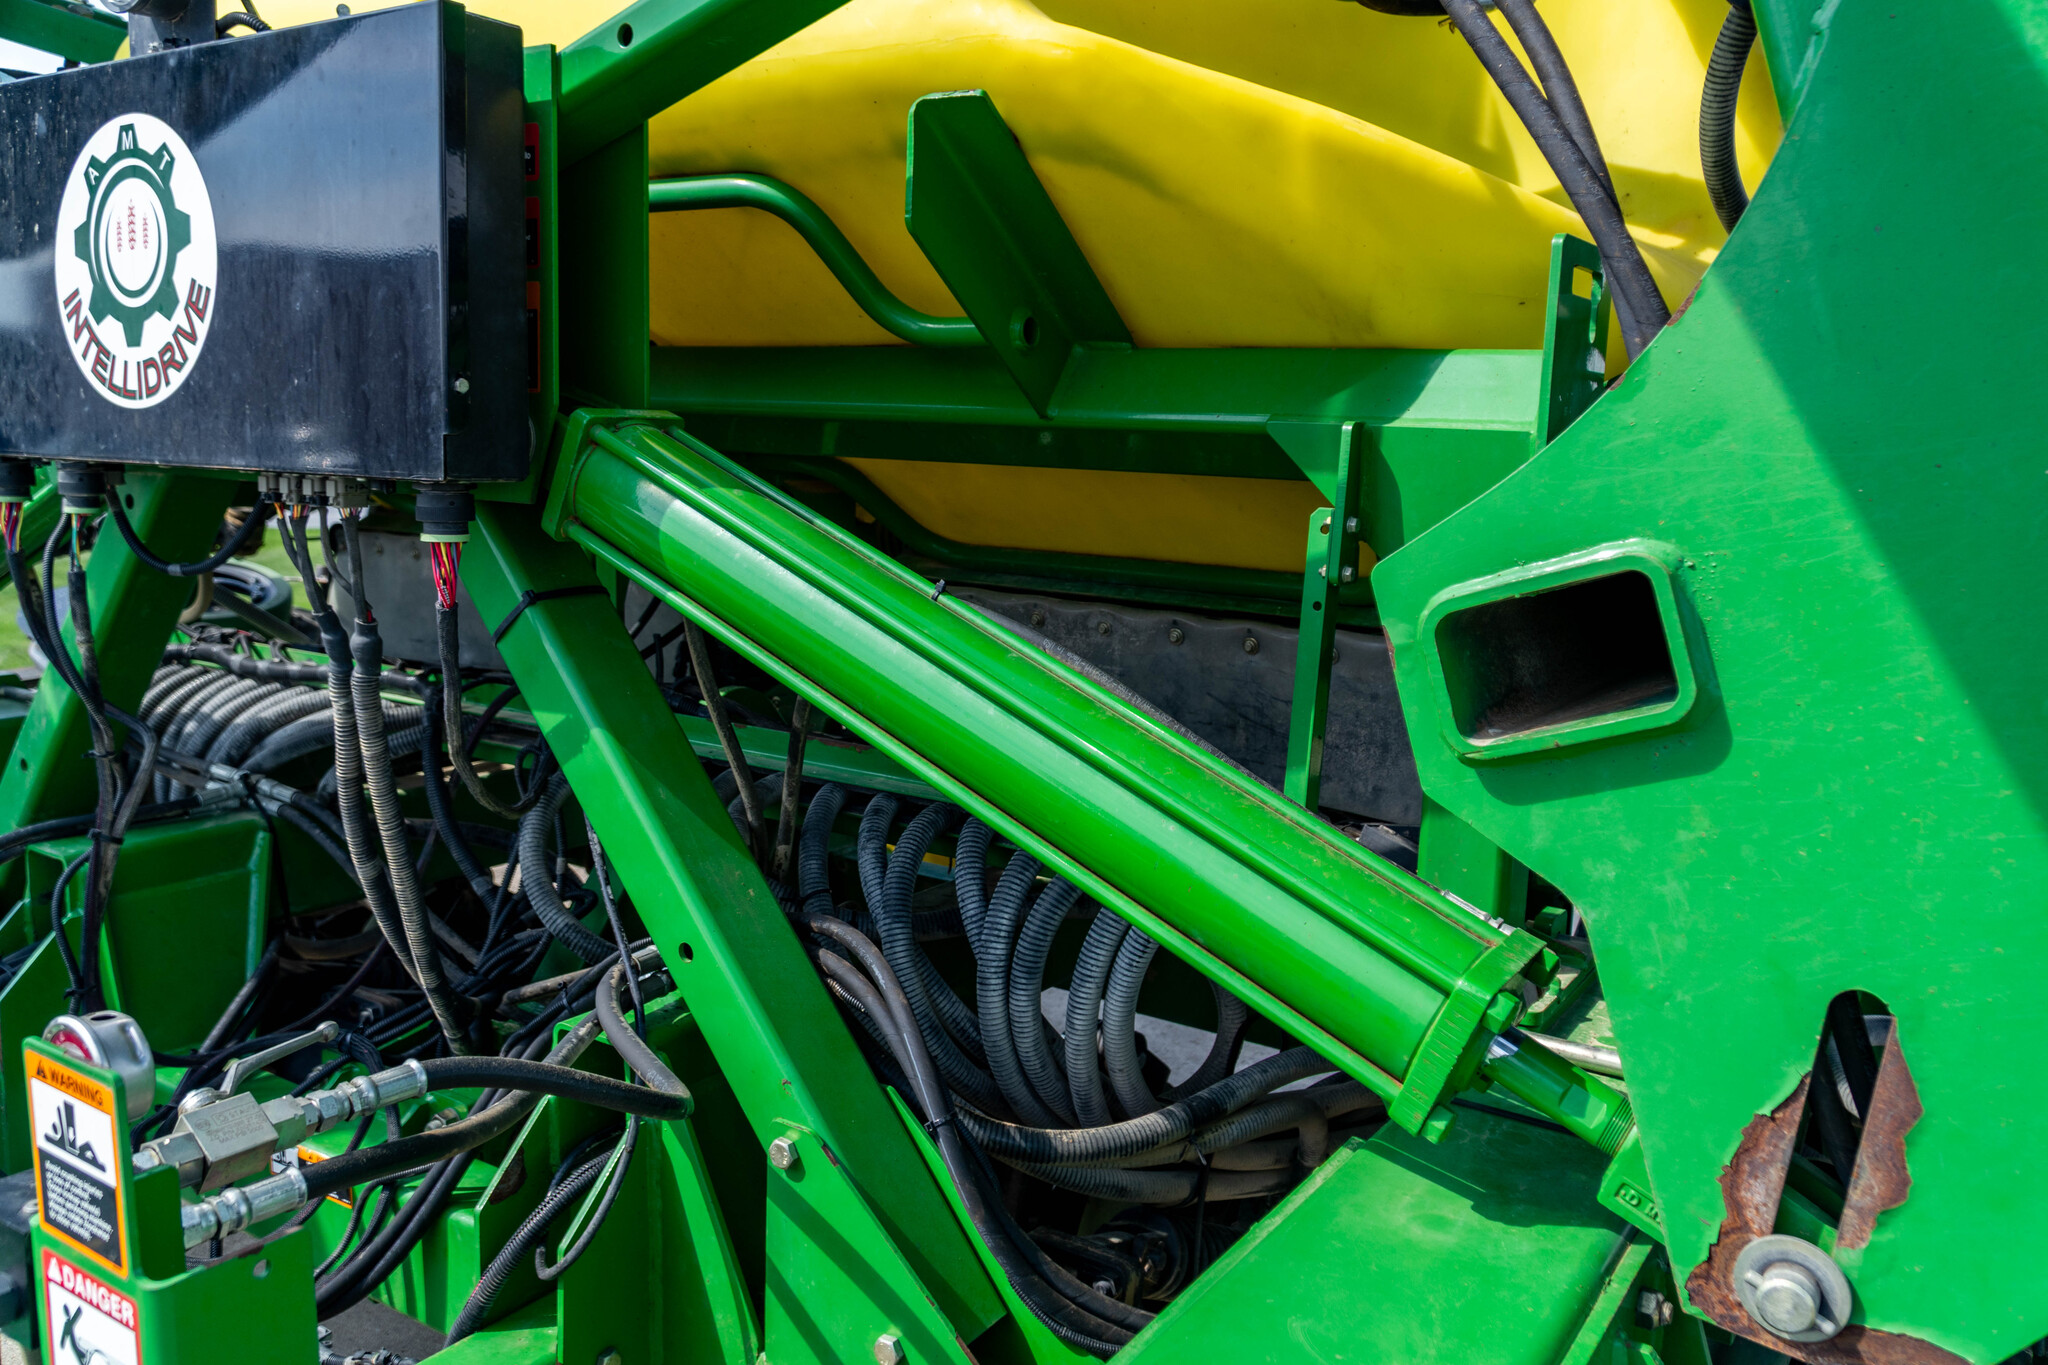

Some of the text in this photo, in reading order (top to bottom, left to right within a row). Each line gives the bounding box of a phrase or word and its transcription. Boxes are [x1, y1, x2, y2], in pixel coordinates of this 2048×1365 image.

[62, 277, 212, 401] INTELLIDRIVE
[49, 1066, 104, 1107] WARNING
[61, 1263, 135, 1330] DANGER
